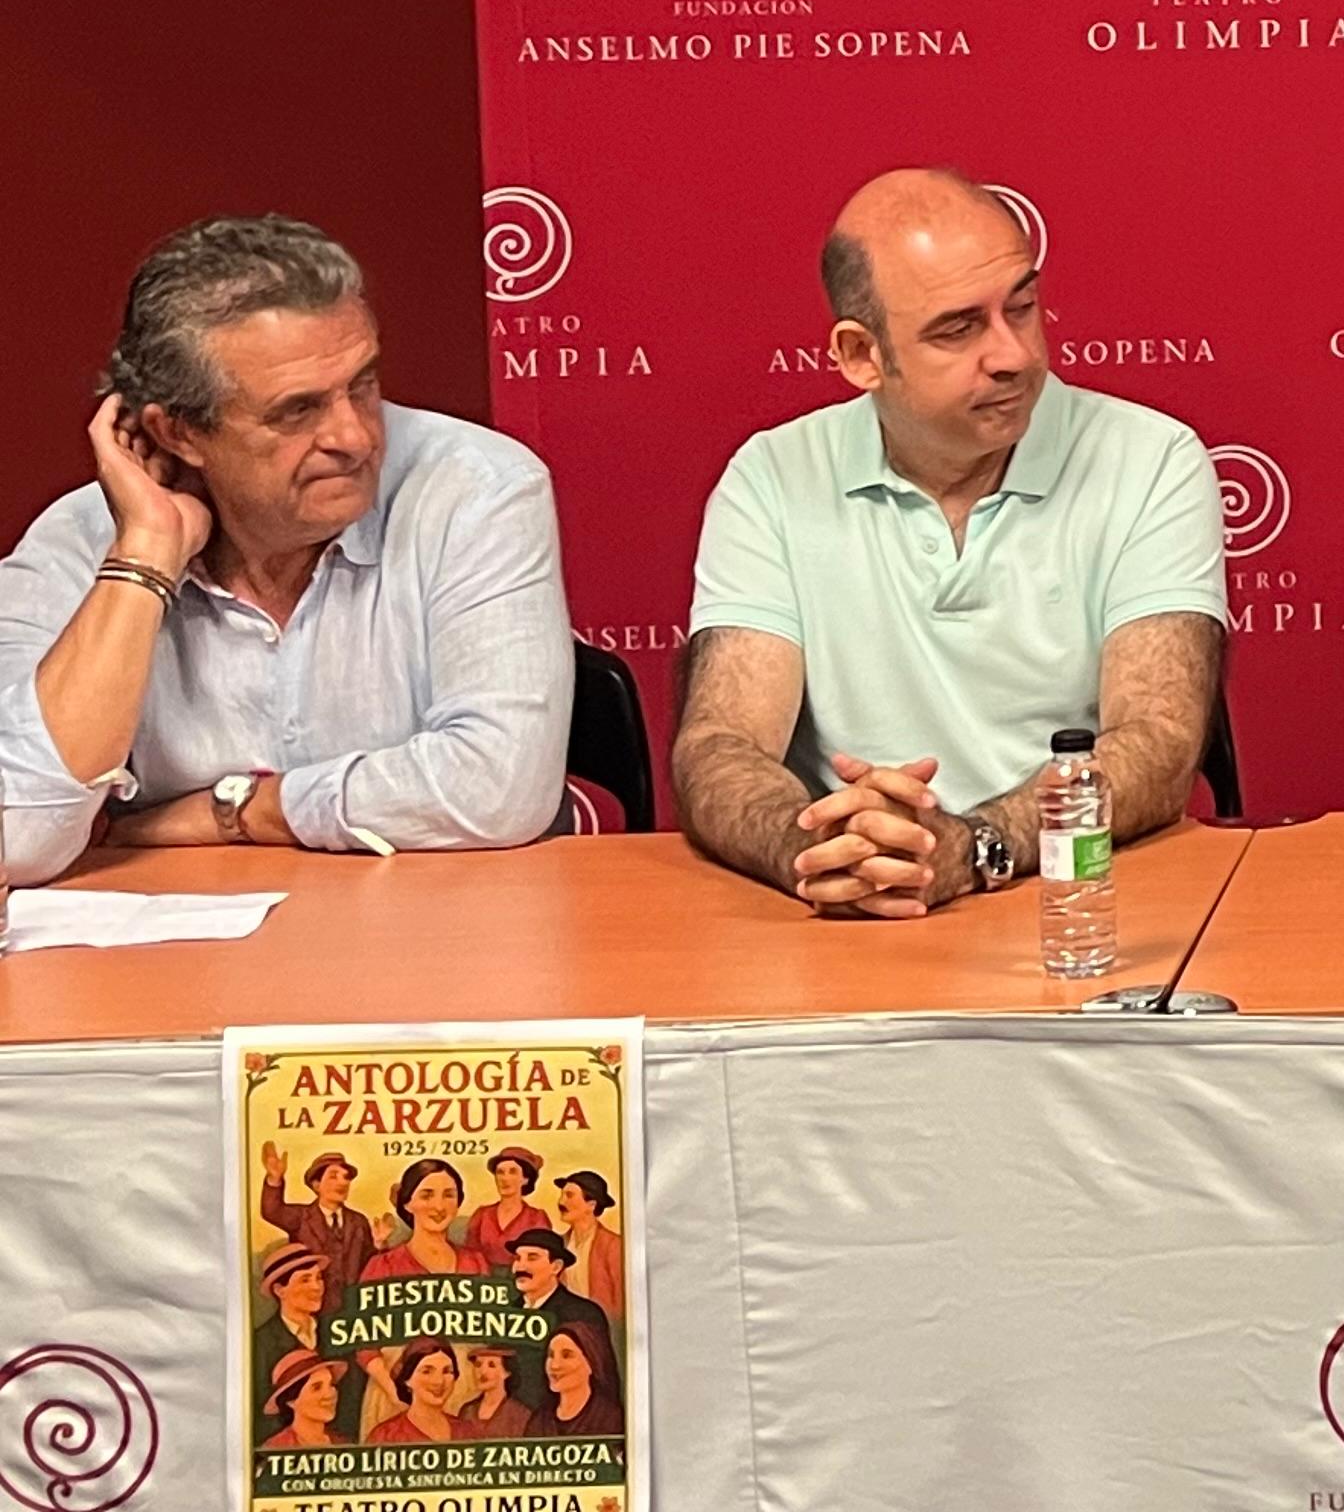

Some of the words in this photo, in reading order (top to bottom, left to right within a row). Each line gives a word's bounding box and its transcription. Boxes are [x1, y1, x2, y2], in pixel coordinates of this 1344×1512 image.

[518, 34, 712, 63] ANSELMO
[734, 33, 794, 59] PIE
[814, 30, 971, 58] SOPENA
[491, 315, 581, 337] ATRO
[503, 346, 652, 380] MPIA
[1060, 337, 1216, 366] SOPENA
[1231, 571, 1298, 589] TRO
[291, 1050, 553, 1097] ANTOLOGÍA
[561, 1068, 591, 1086] DE
[278, 1107, 315, 1129] LA
[323, 1096, 590, 1136] ZARZUELA
[360, 1279, 474, 1310] FIESTAS
[480, 1284, 509, 1306] DE
[330, 1315, 393, 1346] SAN
[404, 1311, 549, 1342] LORENZO
[268, 1452, 354, 1477] TEATRO
[362, 1447, 440, 1473] LÍRICO
[447, 1448, 475, 1469] DE
[483, 1443, 612, 1468] ZARAGOZA
[281, 1478, 316, 1493] CON
[320, 1475, 403, 1492] ORQUESTA
[408, 1471, 494, 1488] SINFÓNICA
[499, 1471, 521, 1486] EN
[525, 1469, 596, 1484] DIRECTO
